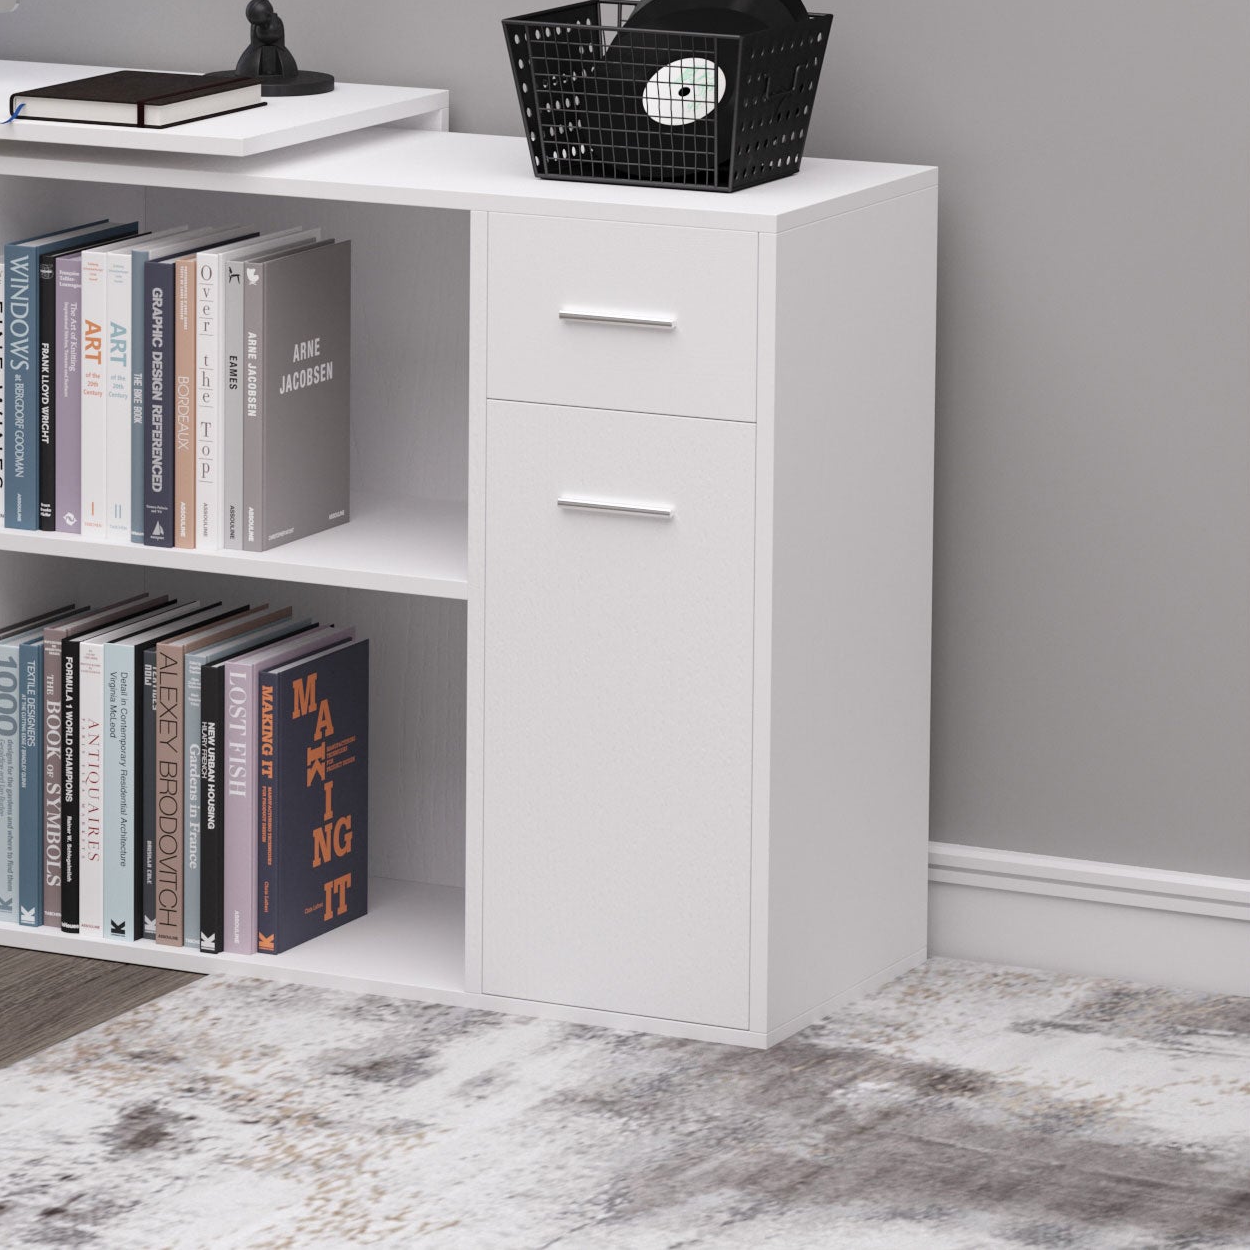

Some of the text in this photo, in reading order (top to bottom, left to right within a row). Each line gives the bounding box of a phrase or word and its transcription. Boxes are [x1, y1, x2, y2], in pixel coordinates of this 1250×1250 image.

[10, 255, 29, 370] WINDOWS
[69, 302, 78, 372] The Art of Knitting
[152, 287, 163, 348] GRAPHIC
[85, 320, 101, 365] ART
[110, 321, 127, 367] ART
[293, 338, 321, 363] ARNE
[42, 343, 50, 444] FRANK LLOYD WRIGHT
[84, 389, 103, 398] Century
[109, 392, 128, 400] Century
[134, 373, 142, 387] THE
[152, 351, 163, 401] DESIGN
[230, 355, 238, 390] EAMES
[248, 332, 257, 417] ARNE JACOBSEN
[280, 362, 333, 395] JACOBSEN
[15, 382, 24, 429] BERGDORF
[134, 406, 142, 424] BOOK
[178, 376, 190, 450] BORDEAUX
[15, 431, 24, 477] GOODMAN
[152, 405, 163, 493] REFERENCED
[27, 660, 36, 747] TEXTILE DESIGNERS
[65, 656, 73, 702] FORMULA
[109, 672, 118, 738] Virginia McLeod
[5, 740, 13, 765] designs
[65, 711, 73, 745] WORLD
[229, 672, 247, 797] LOST FISH
[262, 685, 273, 779] MAKING IT
[47, 675, 61, 887] THE BOOK OF SYMBOLS
[65, 747, 73, 802] CHAMPIONS
[85, 718, 100, 862] ANTIQUAIRES
[119, 672, 128, 867] Detail in Contemporary Residential Architecture
[159, 652, 178, 927] ALEXEY BRODOVITCH
[5, 789, 13, 816] gardens
[190, 744, 200, 869] Gardens in France
[324, 873, 352, 922] IT
